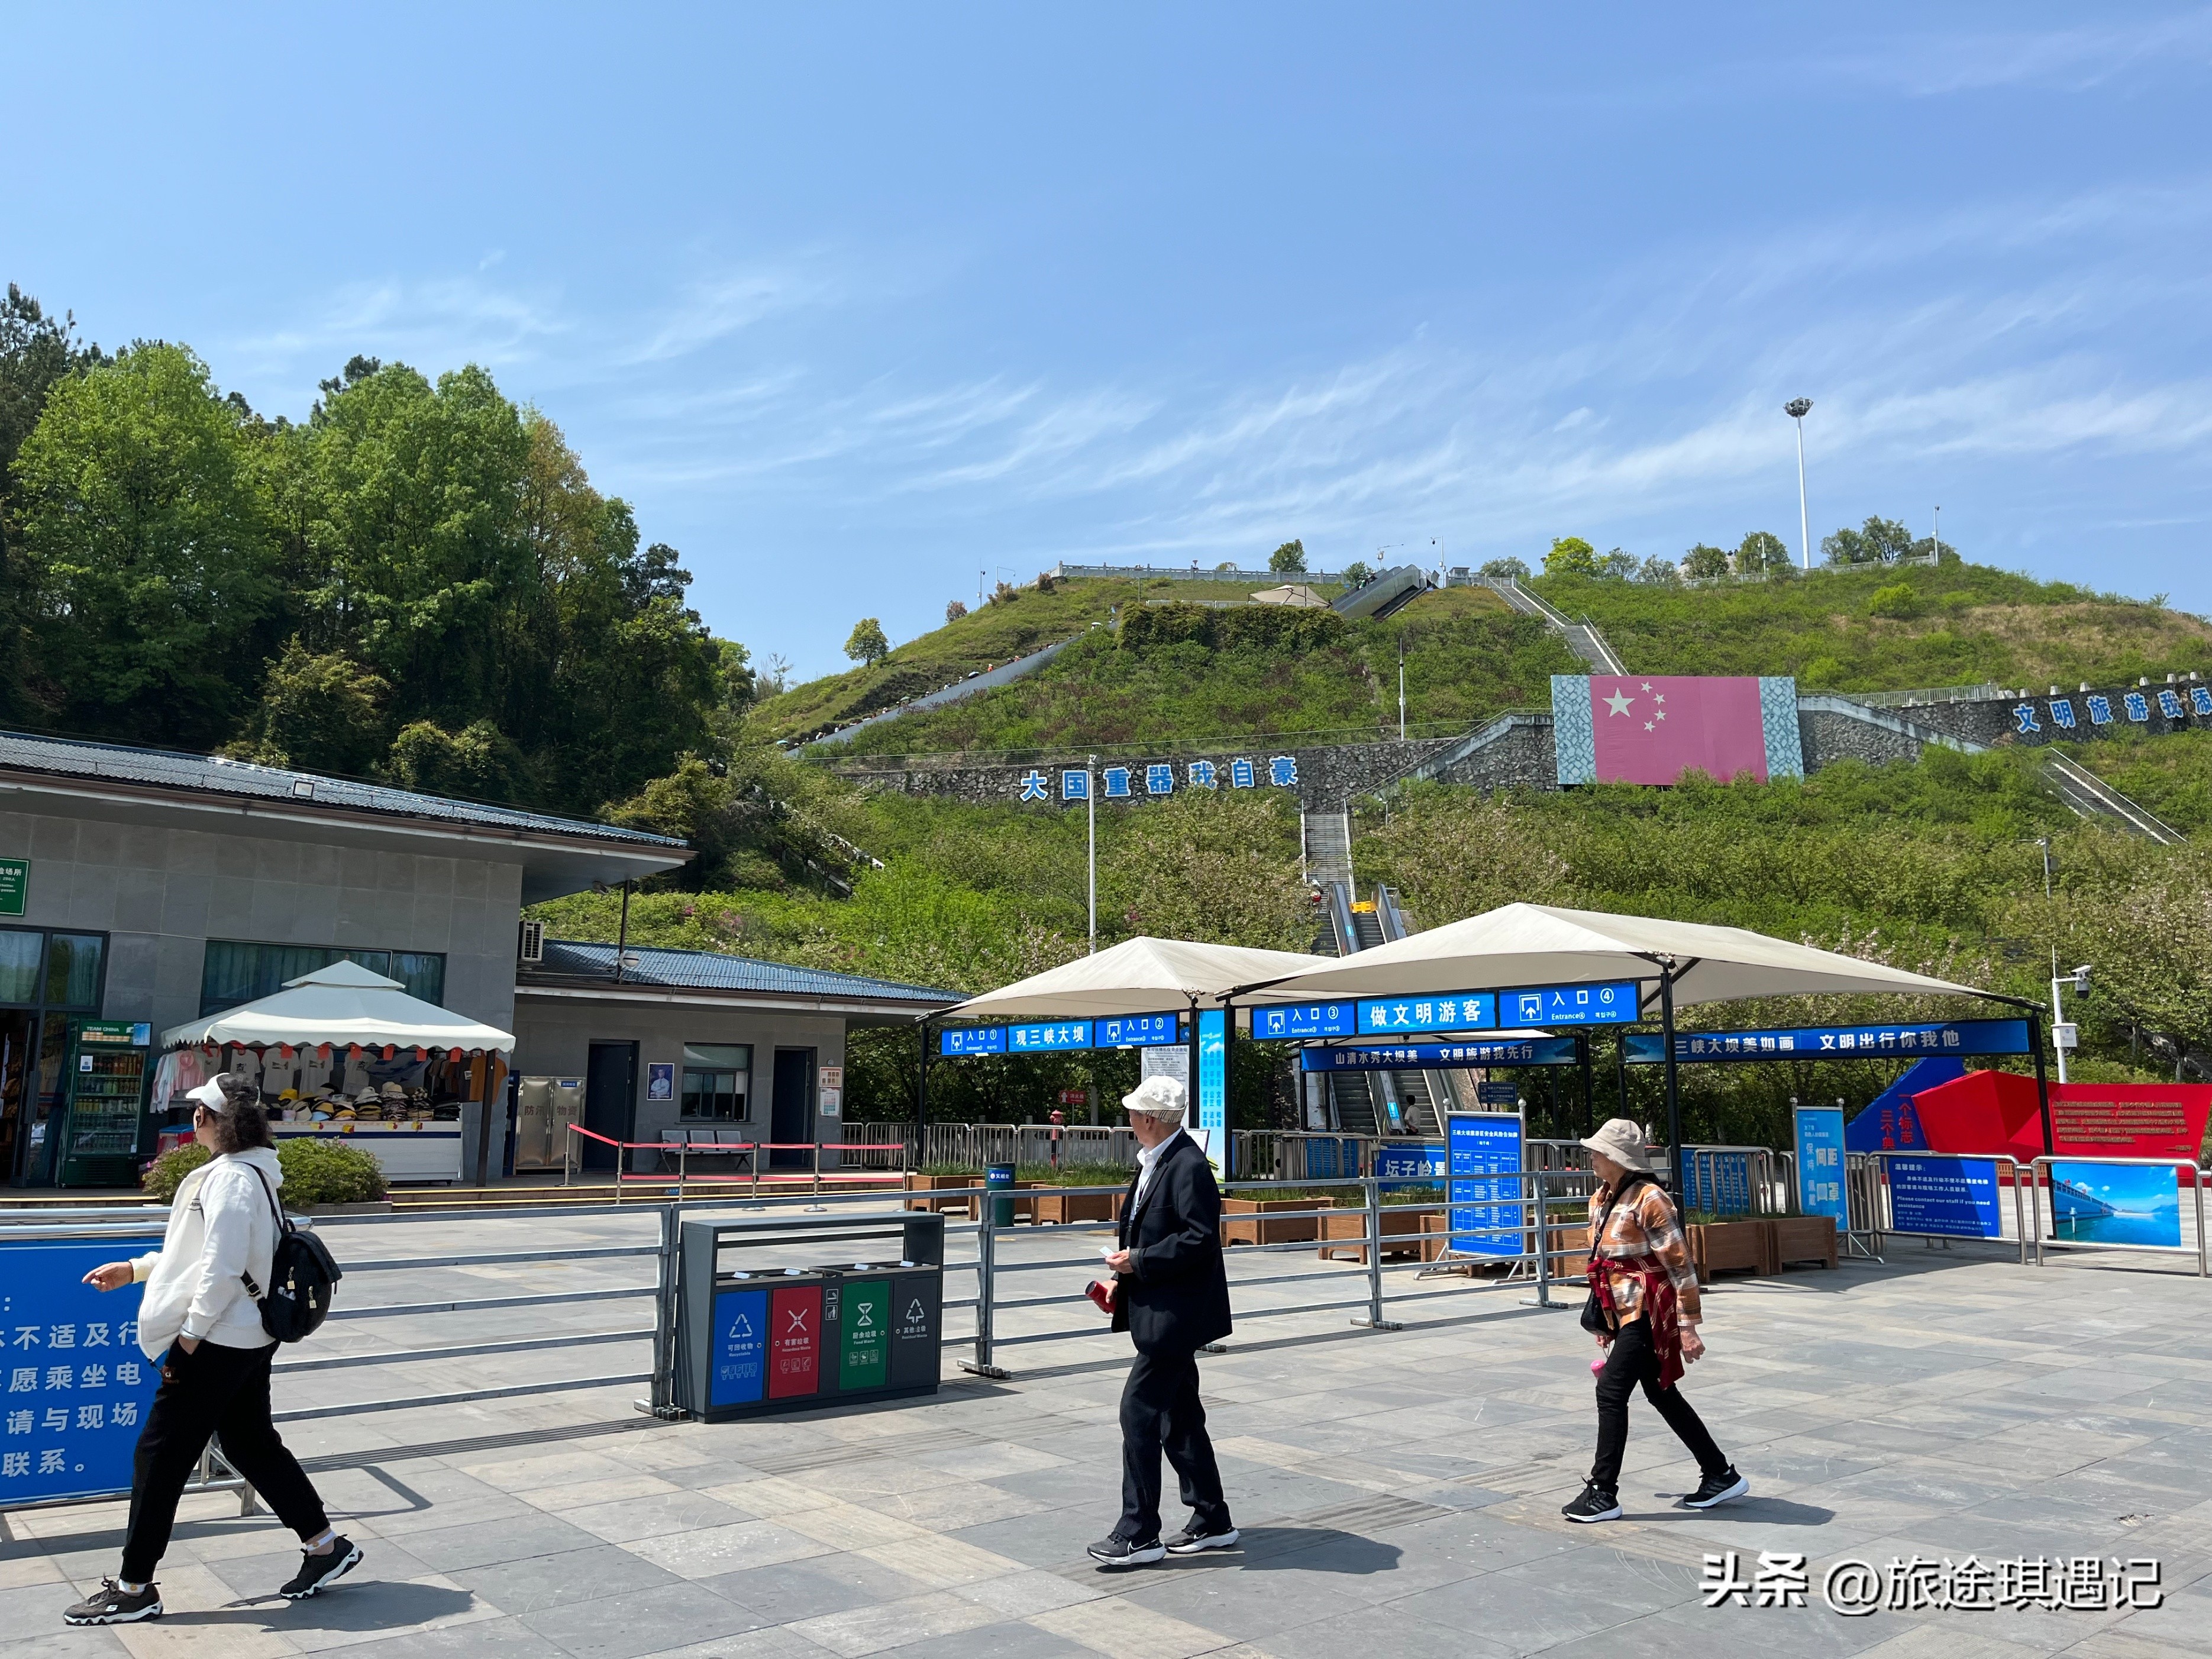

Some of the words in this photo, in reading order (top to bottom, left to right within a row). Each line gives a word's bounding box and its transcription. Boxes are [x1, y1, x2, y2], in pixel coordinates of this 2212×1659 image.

[2013, 686, 2212, 734] 文明旅游我添
[1020, 756, 1299, 802] 大国重器我自豪
[1370, 999, 1481, 1027] 做文明游客
[1016, 1026, 1084, 1046] 观三峡大坝
[1675, 1037, 1794, 1055] 三峡大坝美如画
[1820, 1030, 1960, 1050] 文明出行你我他
[1336, 1050, 1418, 1064] 山清水秀大坝美
[1440, 1045, 1533, 1061] 文明旅游我先行
[525, 1105, 544, 1116] 防汛
[557, 1105, 577, 1116] 物资
[1898, 1095, 1913, 1143] 一个标志
[1806, 1142, 1815, 1171] 保持
[1816, 1148, 1838, 1166] 间距
[0, 1321, 139, 1351] 不适及行
[728, 1343, 753, 1351] 可回收物
[0, 1361, 141, 1392] 愿乘坐电
[7, 1402, 137, 1434] 请与现场
[1, 1448, 85, 1477] 联系。
